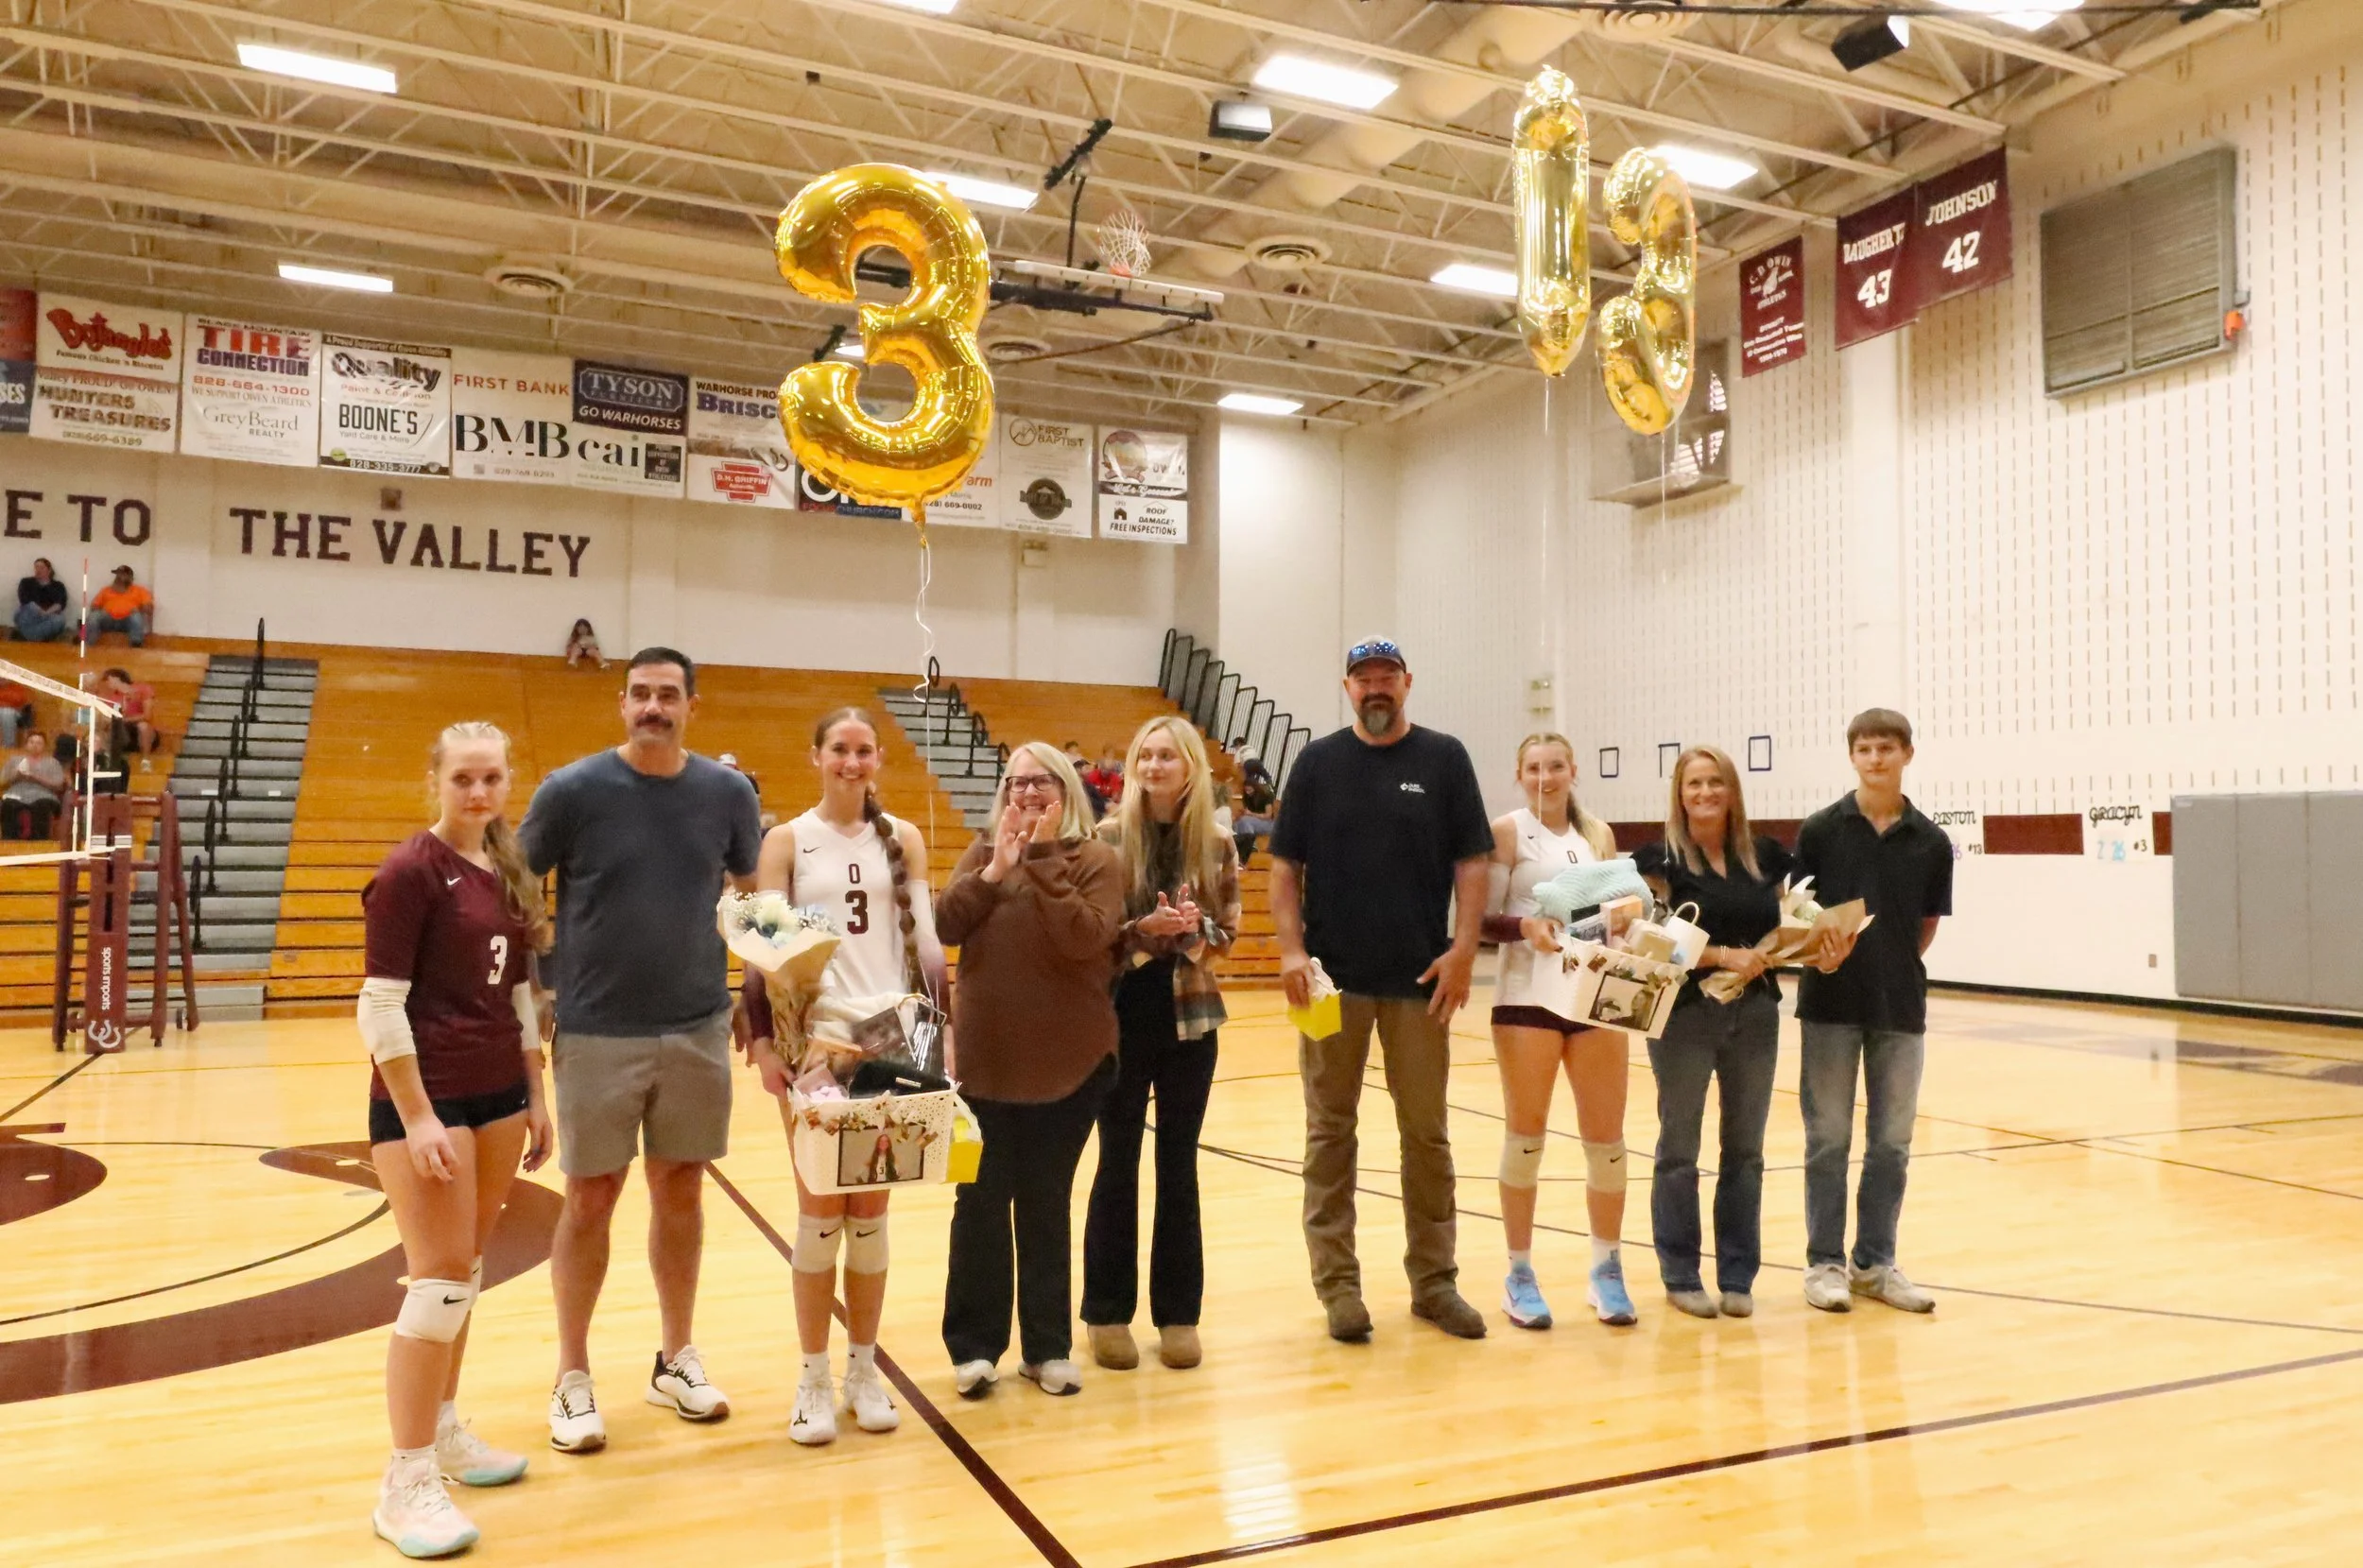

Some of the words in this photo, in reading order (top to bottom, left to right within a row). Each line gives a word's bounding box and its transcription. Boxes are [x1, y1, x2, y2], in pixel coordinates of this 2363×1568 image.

[1924, 180, 1998, 227] JOHNSON
[1941, 231, 1981, 274] 42
[1857, 268, 1892, 309] 43
[197, 324, 311, 360] TIRE
[773, 162, 994, 508] 3
[197, 348, 309, 376] CONNECTION
[332, 352, 441, 392] Quality
[38, 384, 136, 409] HUNTERS
[193, 375, 310, 396] 828-664-1300
[341, 383, 371, 393] Paint
[454, 373, 509, 390] FIRST
[516, 379, 570, 396] BANK
[588, 371, 674, 400] TYSON
[696, 381, 753, 397] WARHORSE
[756, 388, 779, 400] PRO
[50, 404, 172, 433] TREASURES
[578, 405, 599, 417] GO
[602, 409, 681, 430] WARHORSES
[697, 391, 779, 419] BRISC
[249, 428, 285, 439] REALTY
[339, 404, 418, 435] BOONE'S
[1038, 424, 1070, 436] FIRST
[359, 432, 378, 440] Care
[389, 435, 410, 443] More
[456, 414, 570, 458] BMB
[1038, 435, 1084, 447] BAPTIST
[734, 475, 767, 486] GRIFFIN
[966, 475, 992, 487] arm
[4, 489, 43, 539] E
[67, 493, 151, 546] TO
[230, 508, 352, 561] THE
[372, 519, 591, 577] VALLEY
[1110, 523, 1128, 532] FREE
[1129, 525, 1177, 536] INSPECTIONS
[1138, 516, 1175, 526] DAMAGE?
[845, 889, 869, 935] 3
[101, 947, 112, 975] sports
[487, 935, 508, 985] 3
[101, 976, 112, 1011] imports
